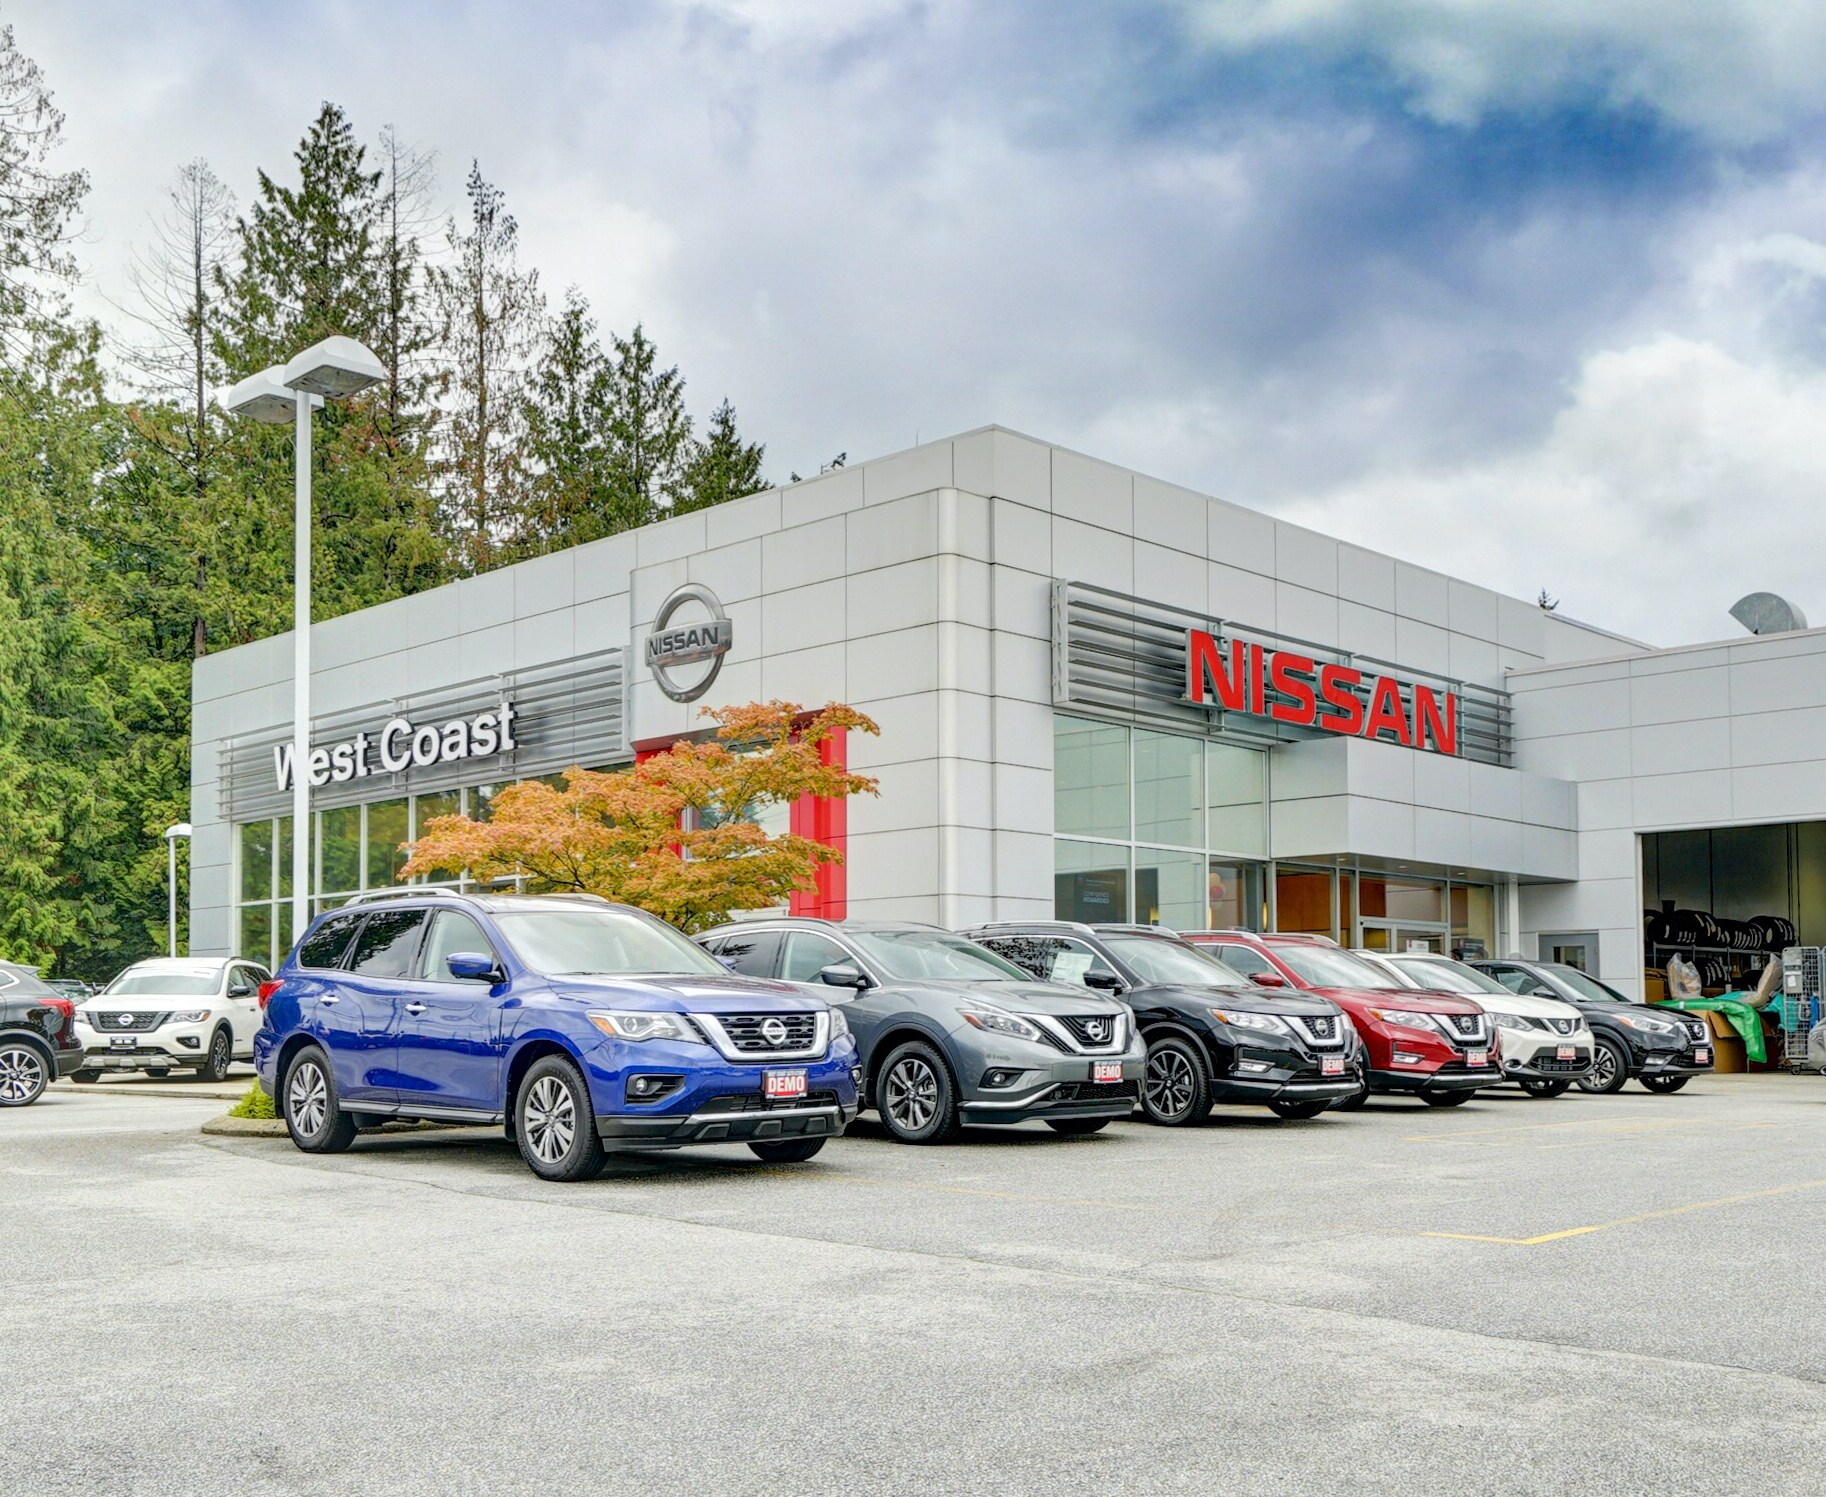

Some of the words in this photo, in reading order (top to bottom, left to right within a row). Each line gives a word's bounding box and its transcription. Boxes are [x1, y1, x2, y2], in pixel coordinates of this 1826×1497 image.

[649, 626, 719, 658] NISSAN
[1185, 628, 1457, 755] NISSAN
[274, 732, 372, 792] West
[380, 701, 518, 773] Coast
[1094, 1065, 1122, 1079] DEMO
[1322, 1059, 1345, 1072] DEMO
[768, 1076, 806, 1093] DEMO
